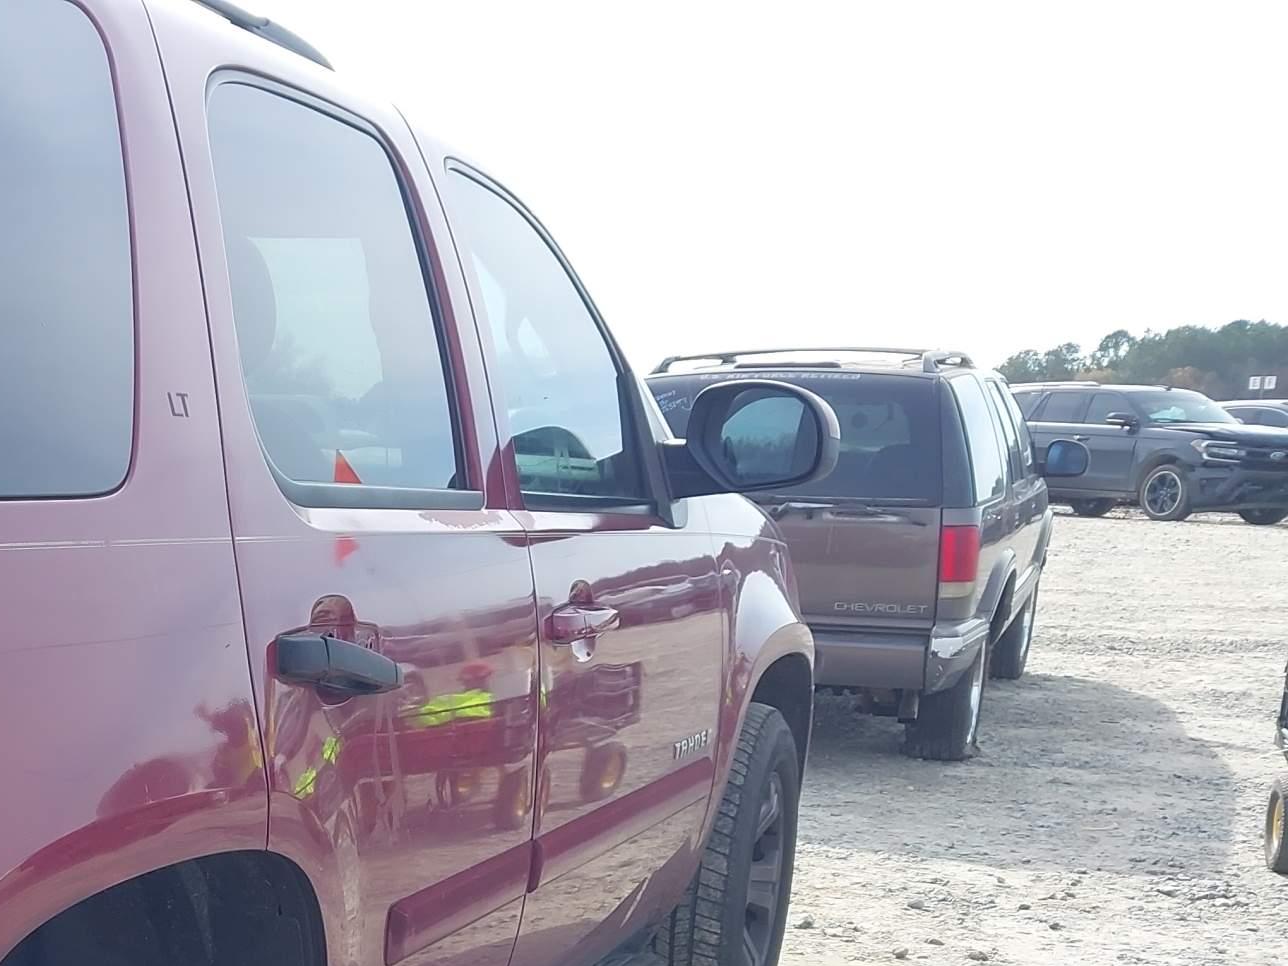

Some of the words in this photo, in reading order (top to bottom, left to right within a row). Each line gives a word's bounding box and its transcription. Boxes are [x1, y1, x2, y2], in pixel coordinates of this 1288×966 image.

[167, 392, 190, 418] LT
[834, 602, 929, 614] CHEVROLET
[673, 730, 709, 760] TAHOE
